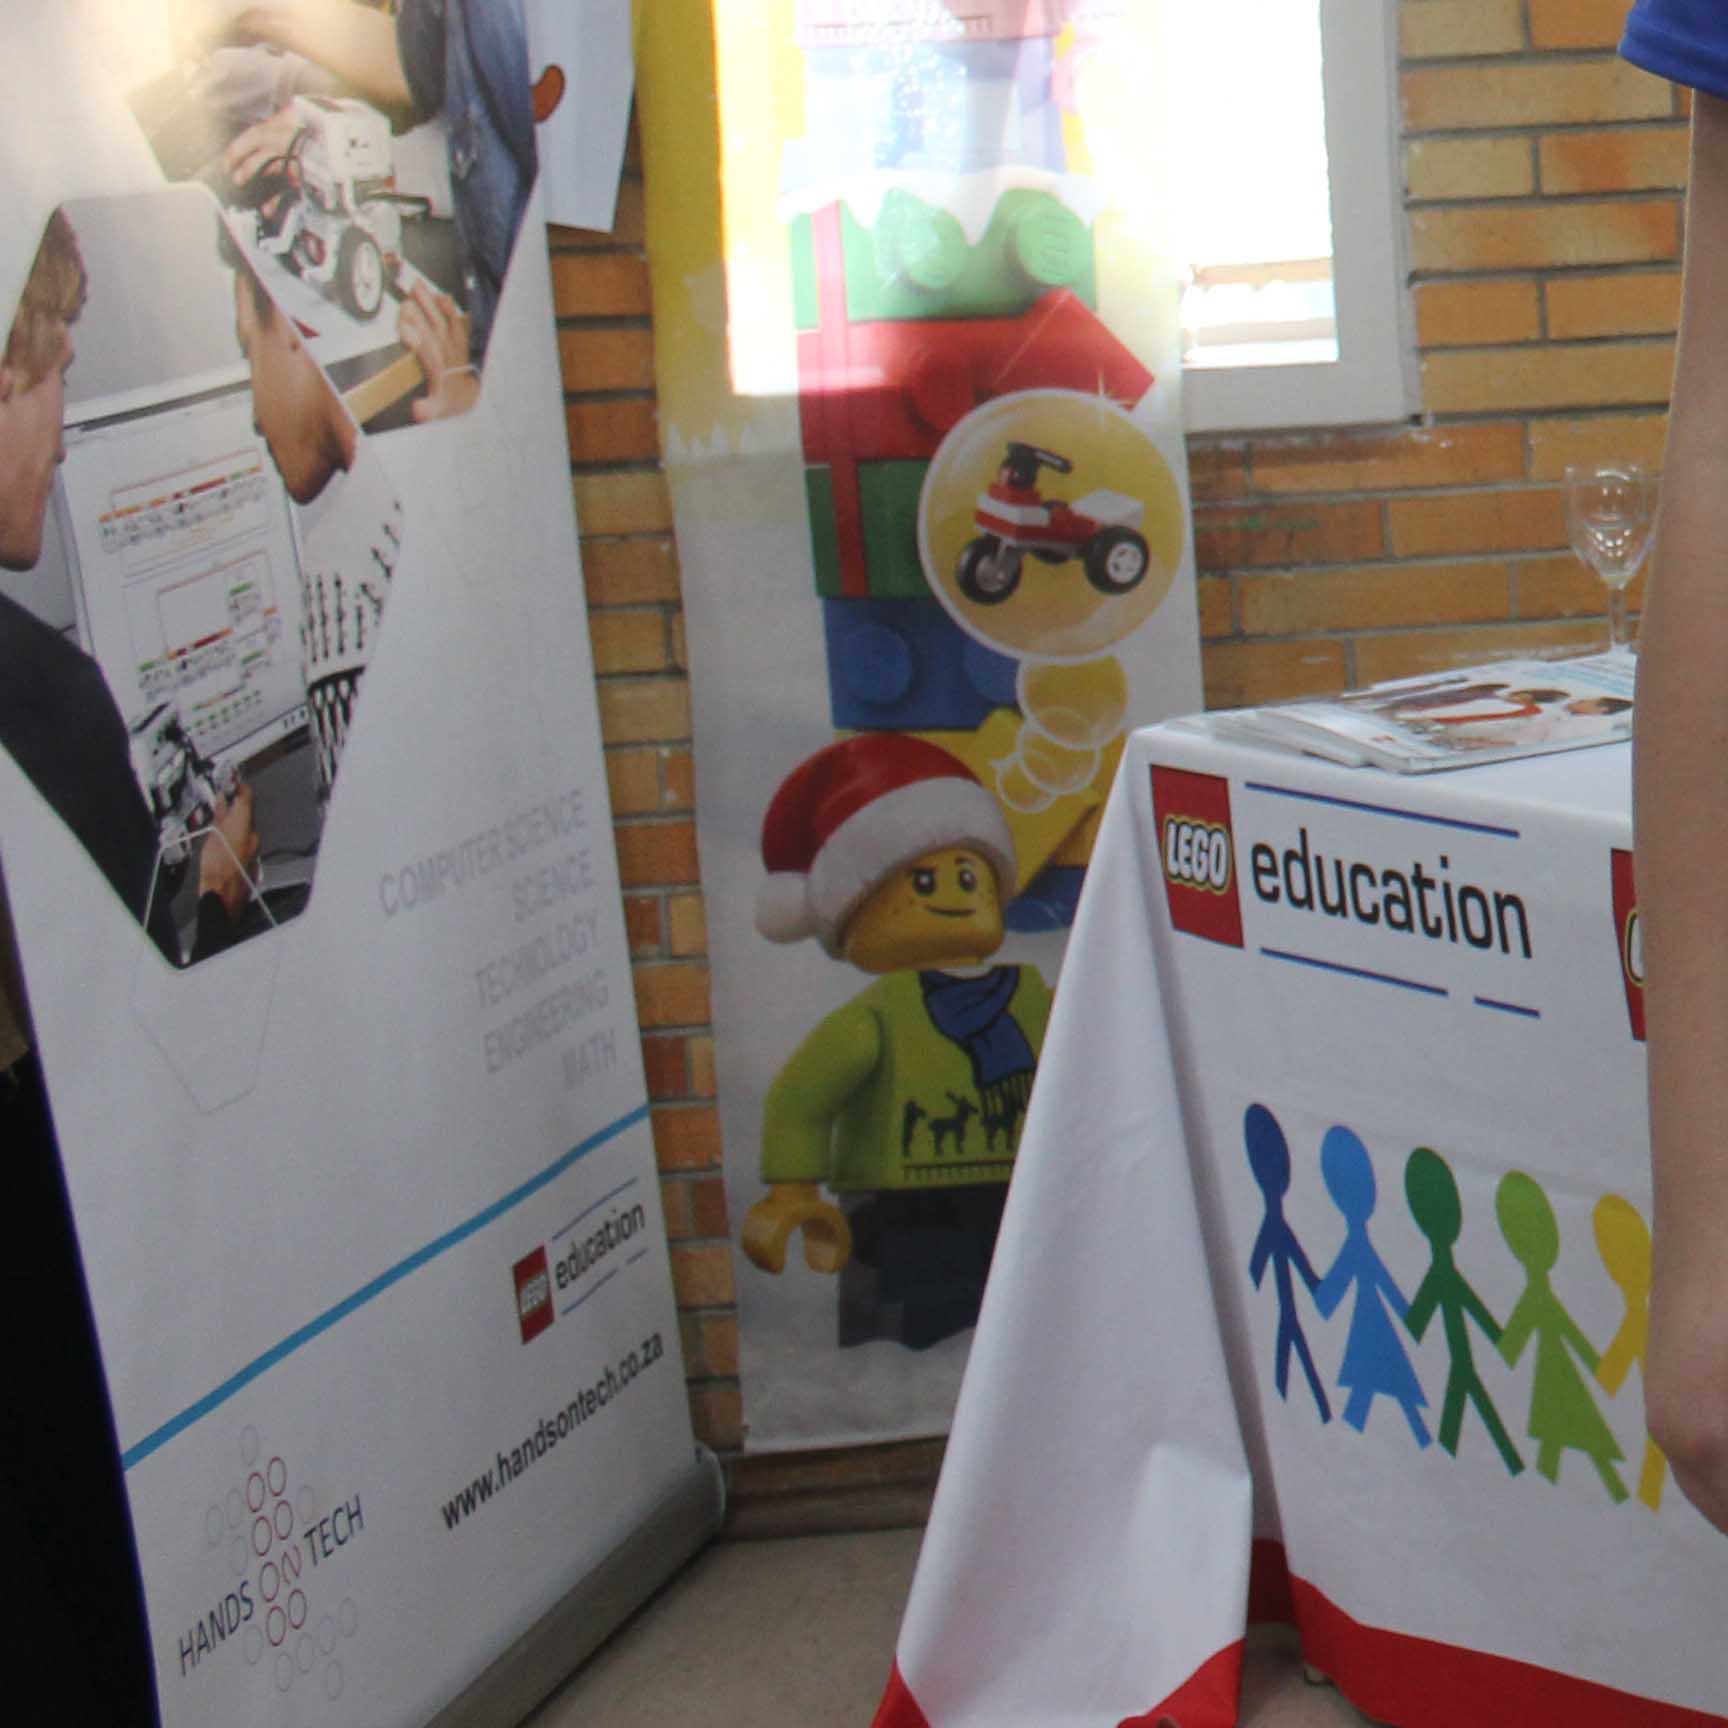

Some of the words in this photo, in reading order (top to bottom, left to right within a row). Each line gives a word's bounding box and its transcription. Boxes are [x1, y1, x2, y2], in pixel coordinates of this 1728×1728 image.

[378, 822, 505, 917] COMPUTER
[503, 788, 587, 860] SCIENCE
[510, 848, 593, 924] SCIENCE
[1163, 818, 1231, 892] LEGO
[1251, 828, 1533, 960] education
[473, 908, 600, 1010] TECHNOLOGY
[482, 968, 610, 1075] ENGINEERING
[560, 1028, 617, 1090] MATH
[556, 1203, 646, 1290] education
[441, 1331, 663, 1530] www.handsontech.co.za
[177, 1580, 255, 1676] HANDS
[259, 1544, 300, 1603] ON
[303, 1494, 365, 1566] TECH
